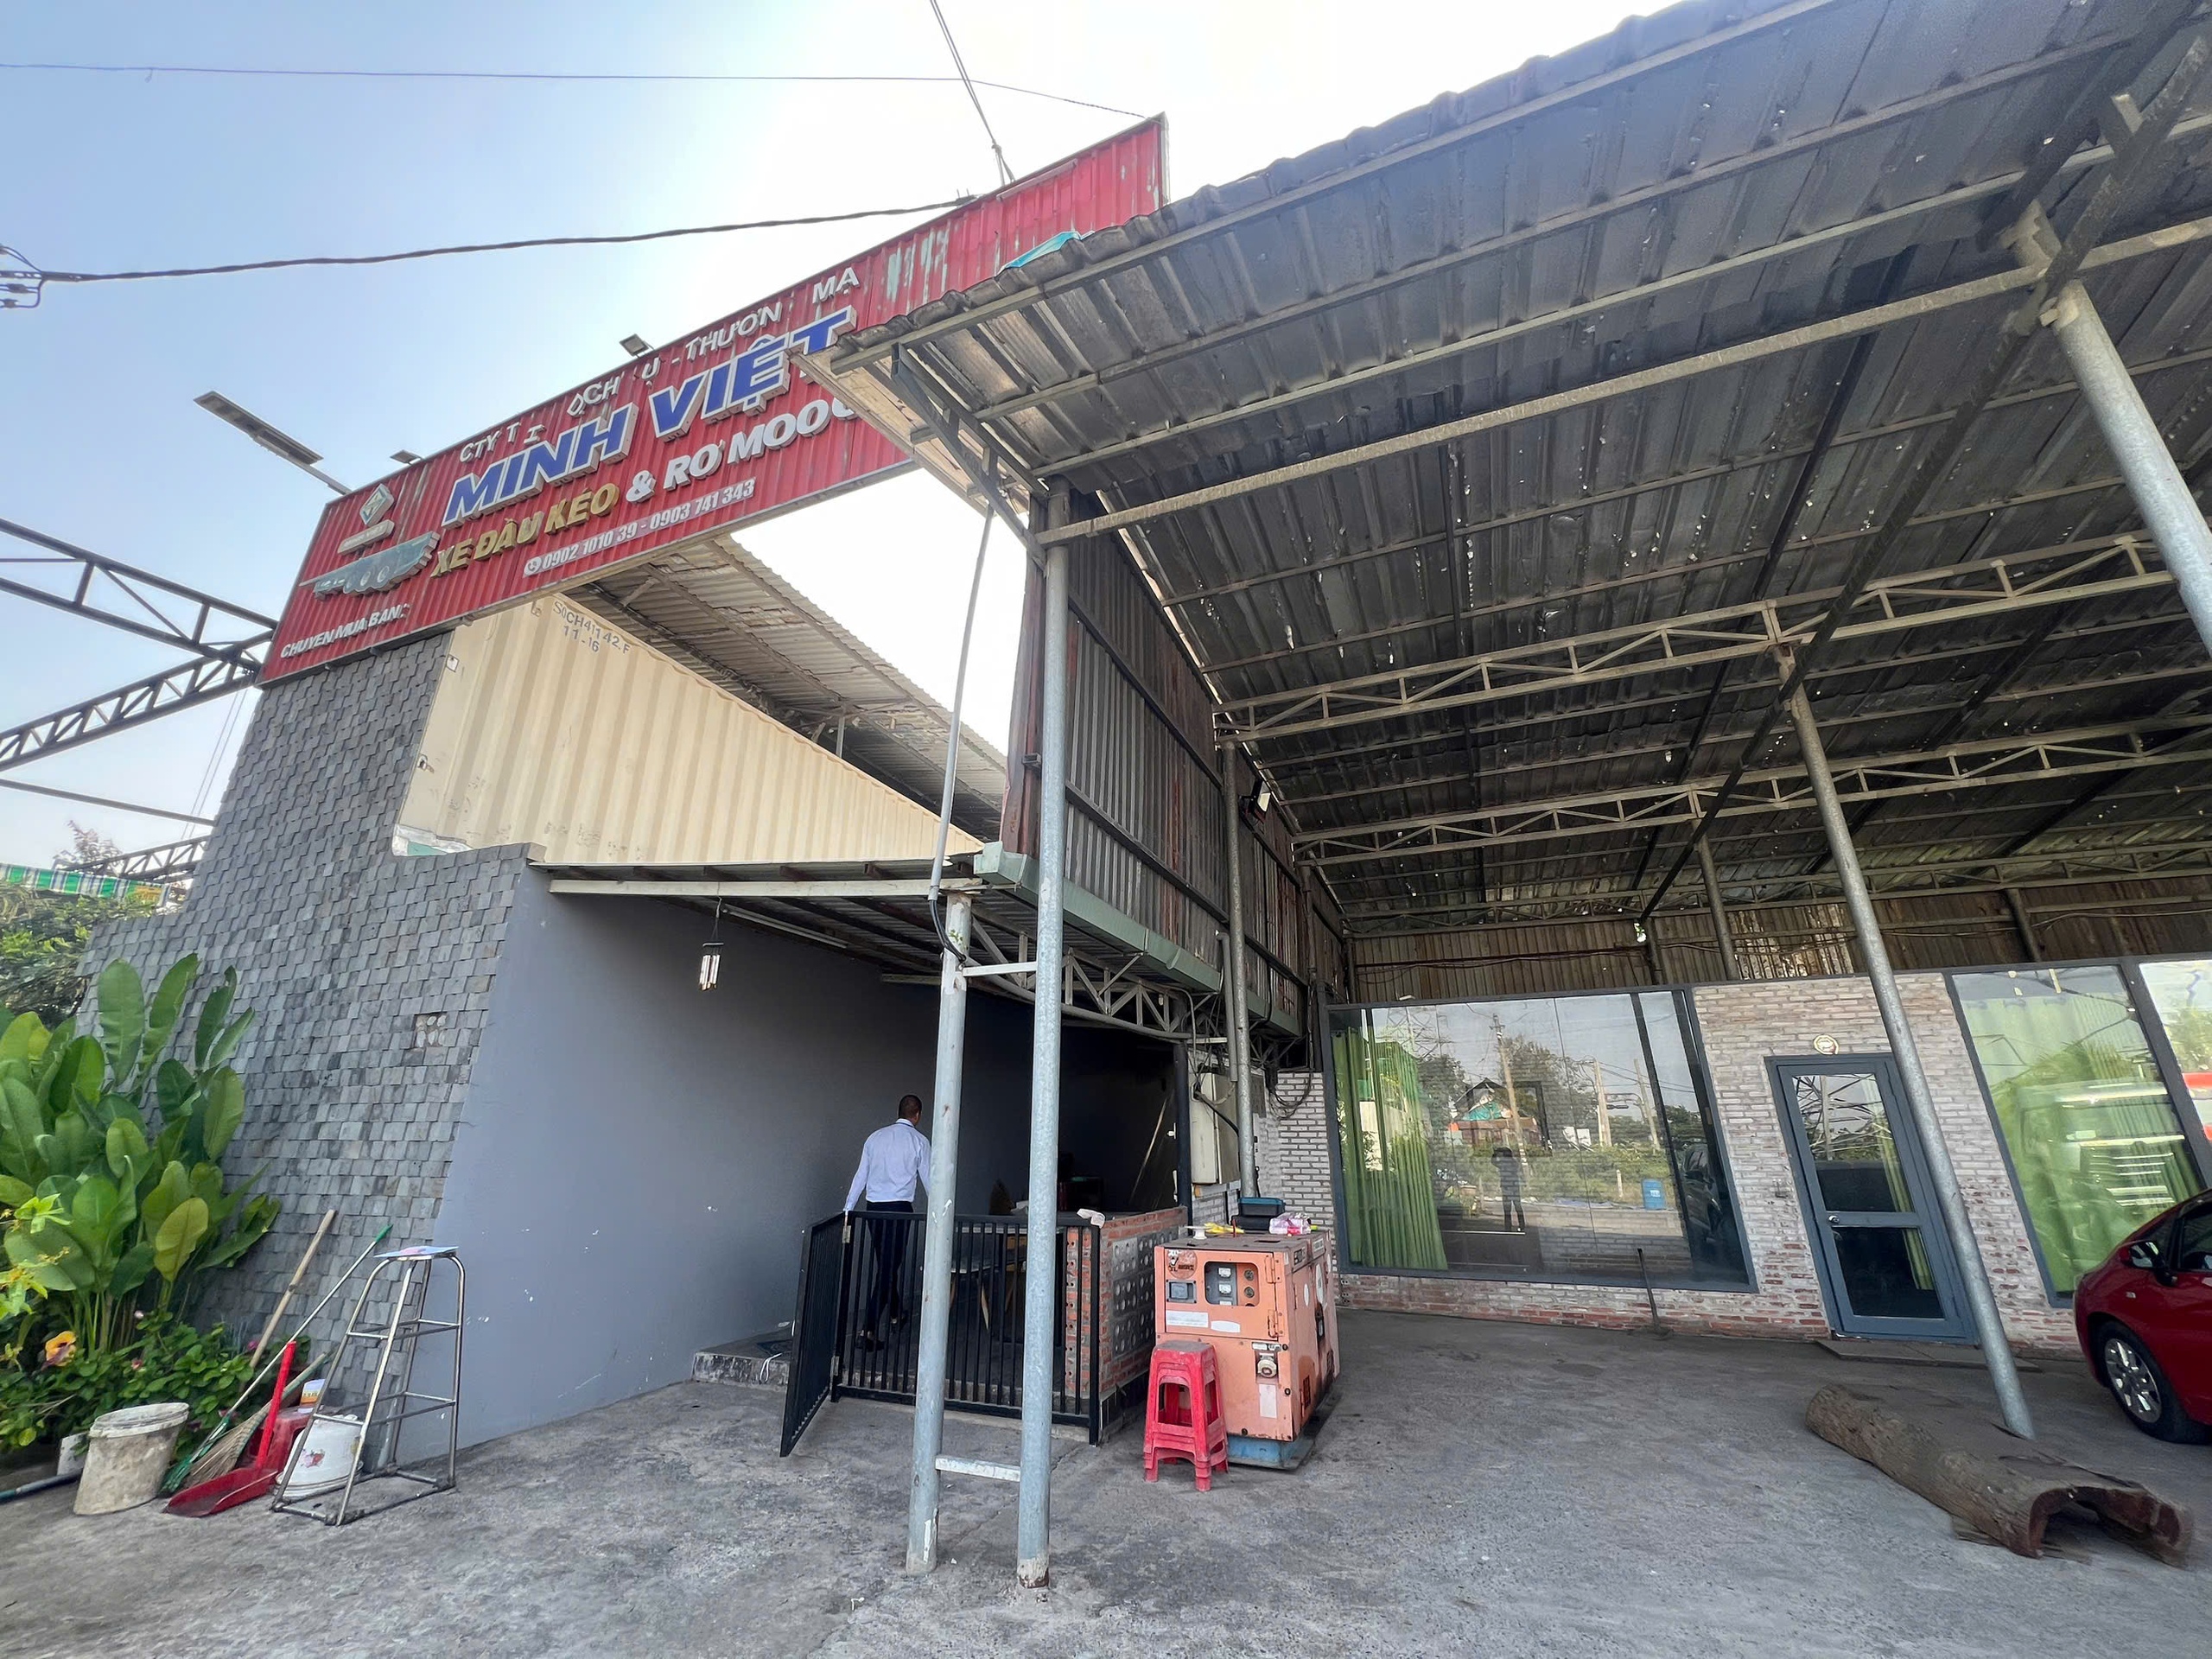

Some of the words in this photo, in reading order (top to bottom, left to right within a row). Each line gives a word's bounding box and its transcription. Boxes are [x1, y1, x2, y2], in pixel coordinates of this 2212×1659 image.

[441, 402, 639, 529] MINH
[649, 305, 857, 442] VIỆT
[460, 430, 500, 463] CTY
[430, 537, 474, 578] XE
[474, 511, 544, 561] ĐẦU
[544, 483, 620, 535] KÉO
[626, 470, 657, 504] &
[663, 439, 726, 491] RƠ
[542, 543, 579, 570] 0902
[582, 531, 613, 556] 1010
[616, 522, 639, 543] 39
[649, 502, 691, 531] 0903
[695, 491, 721, 515] 741
[721, 479, 755, 505] 343
[334, 617, 369, 640] MUA
